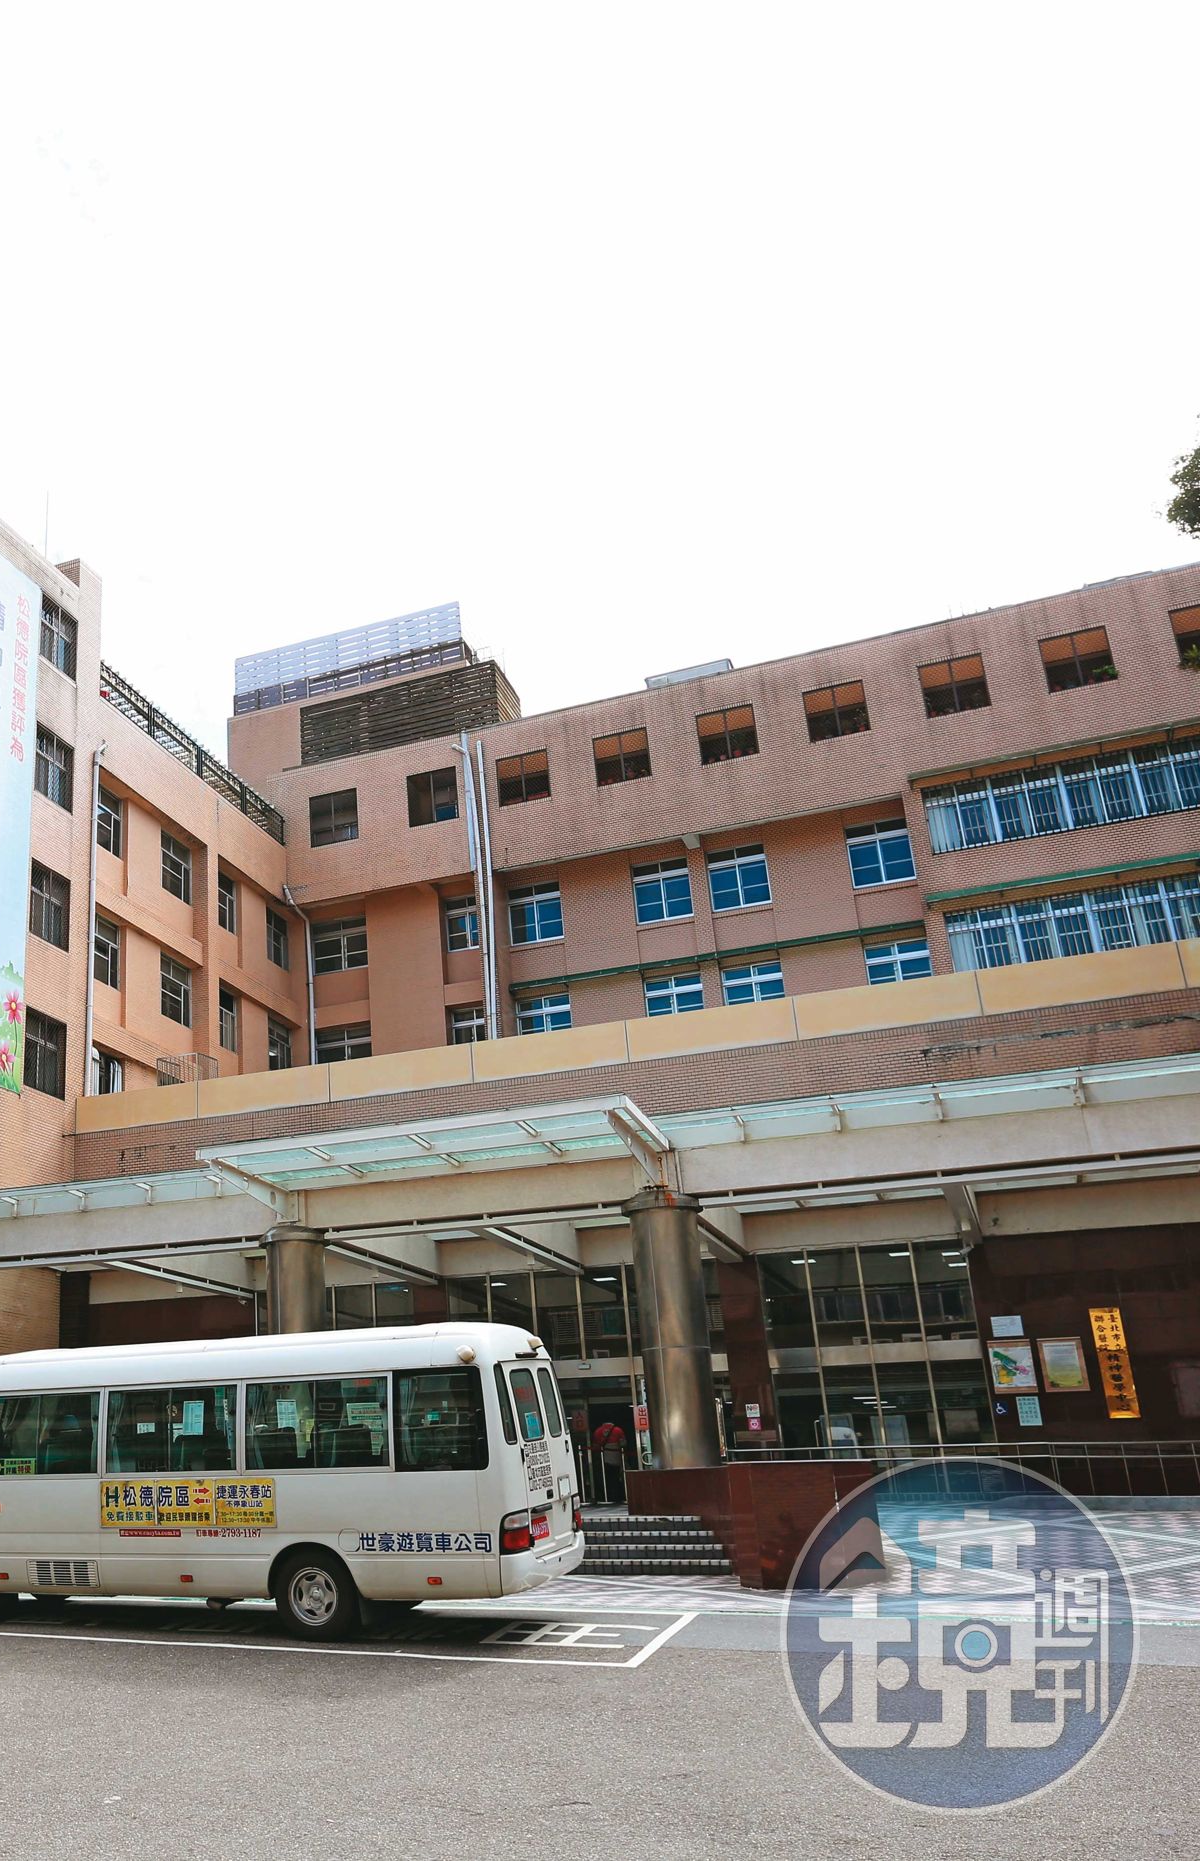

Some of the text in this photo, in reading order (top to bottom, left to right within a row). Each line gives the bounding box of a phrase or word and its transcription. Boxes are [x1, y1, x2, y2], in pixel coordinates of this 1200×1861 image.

[216, 1484, 272, 1499] 捷運永春站
[106, 1511, 154, 1522] 免費接駁車
[359, 1532, 492, 1553] 世豪遊覽車公司
